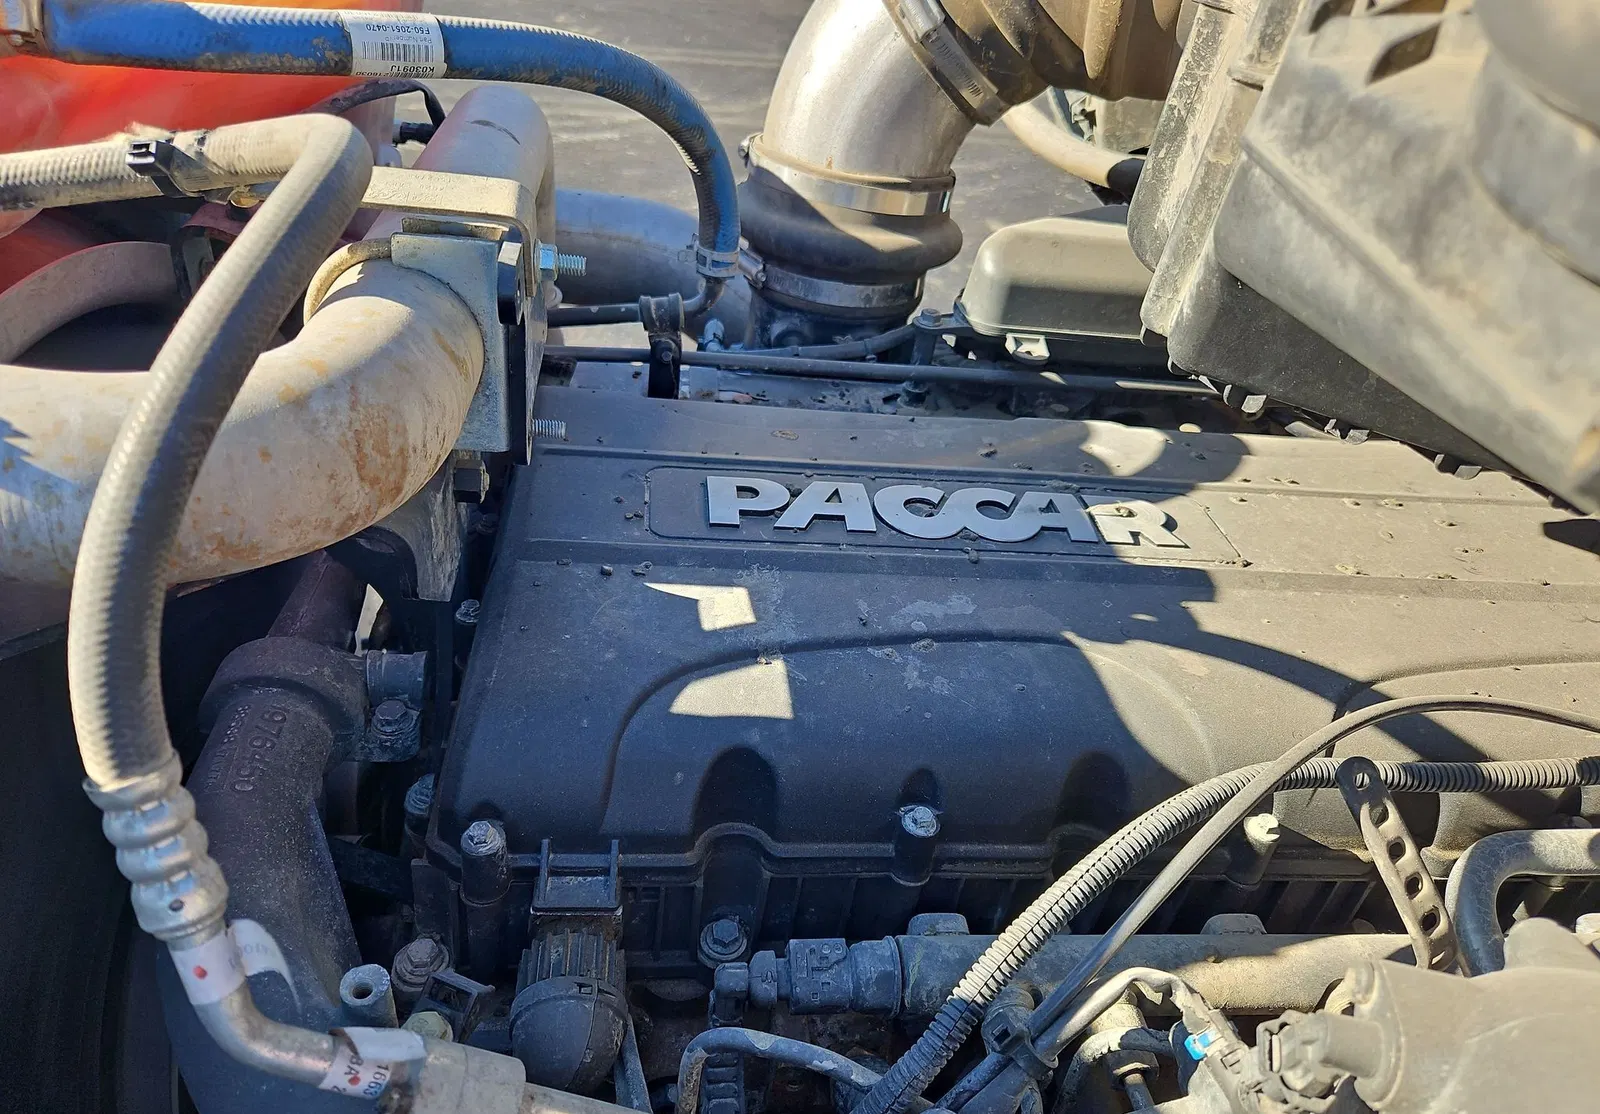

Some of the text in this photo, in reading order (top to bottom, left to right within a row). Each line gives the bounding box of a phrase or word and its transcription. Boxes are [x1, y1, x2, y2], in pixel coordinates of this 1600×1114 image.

[365, 23, 430, 34] F50-2051-0470
[390, 65, 435, 73] K03091J
[705, 475, 1190, 548] PACCAR
